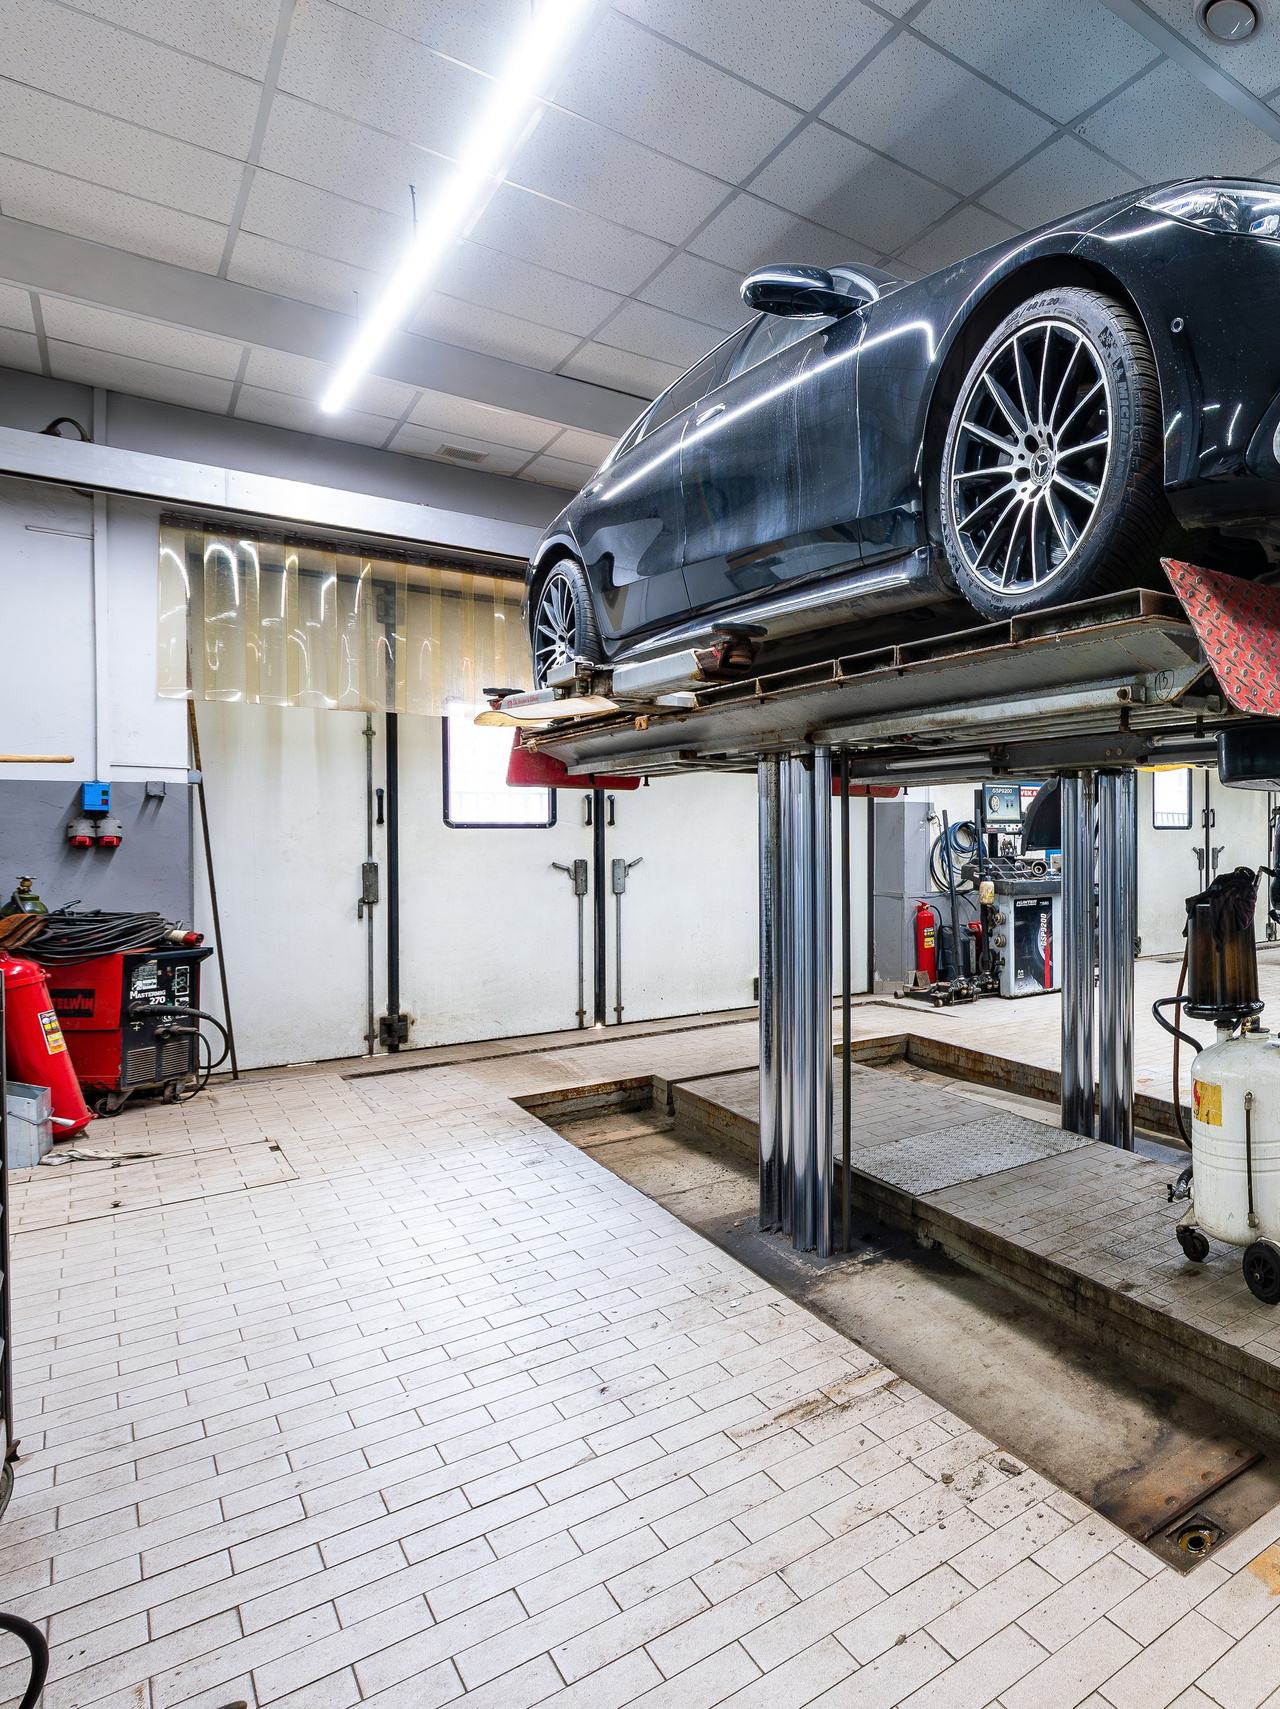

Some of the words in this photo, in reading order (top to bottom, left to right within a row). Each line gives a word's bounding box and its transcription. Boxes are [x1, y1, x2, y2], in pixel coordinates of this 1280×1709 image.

[1115, 381, 1131, 480] MICHELIN
[1040, 913, 1048, 947] GSP9200
[150, 995, 166, 1005] 270
